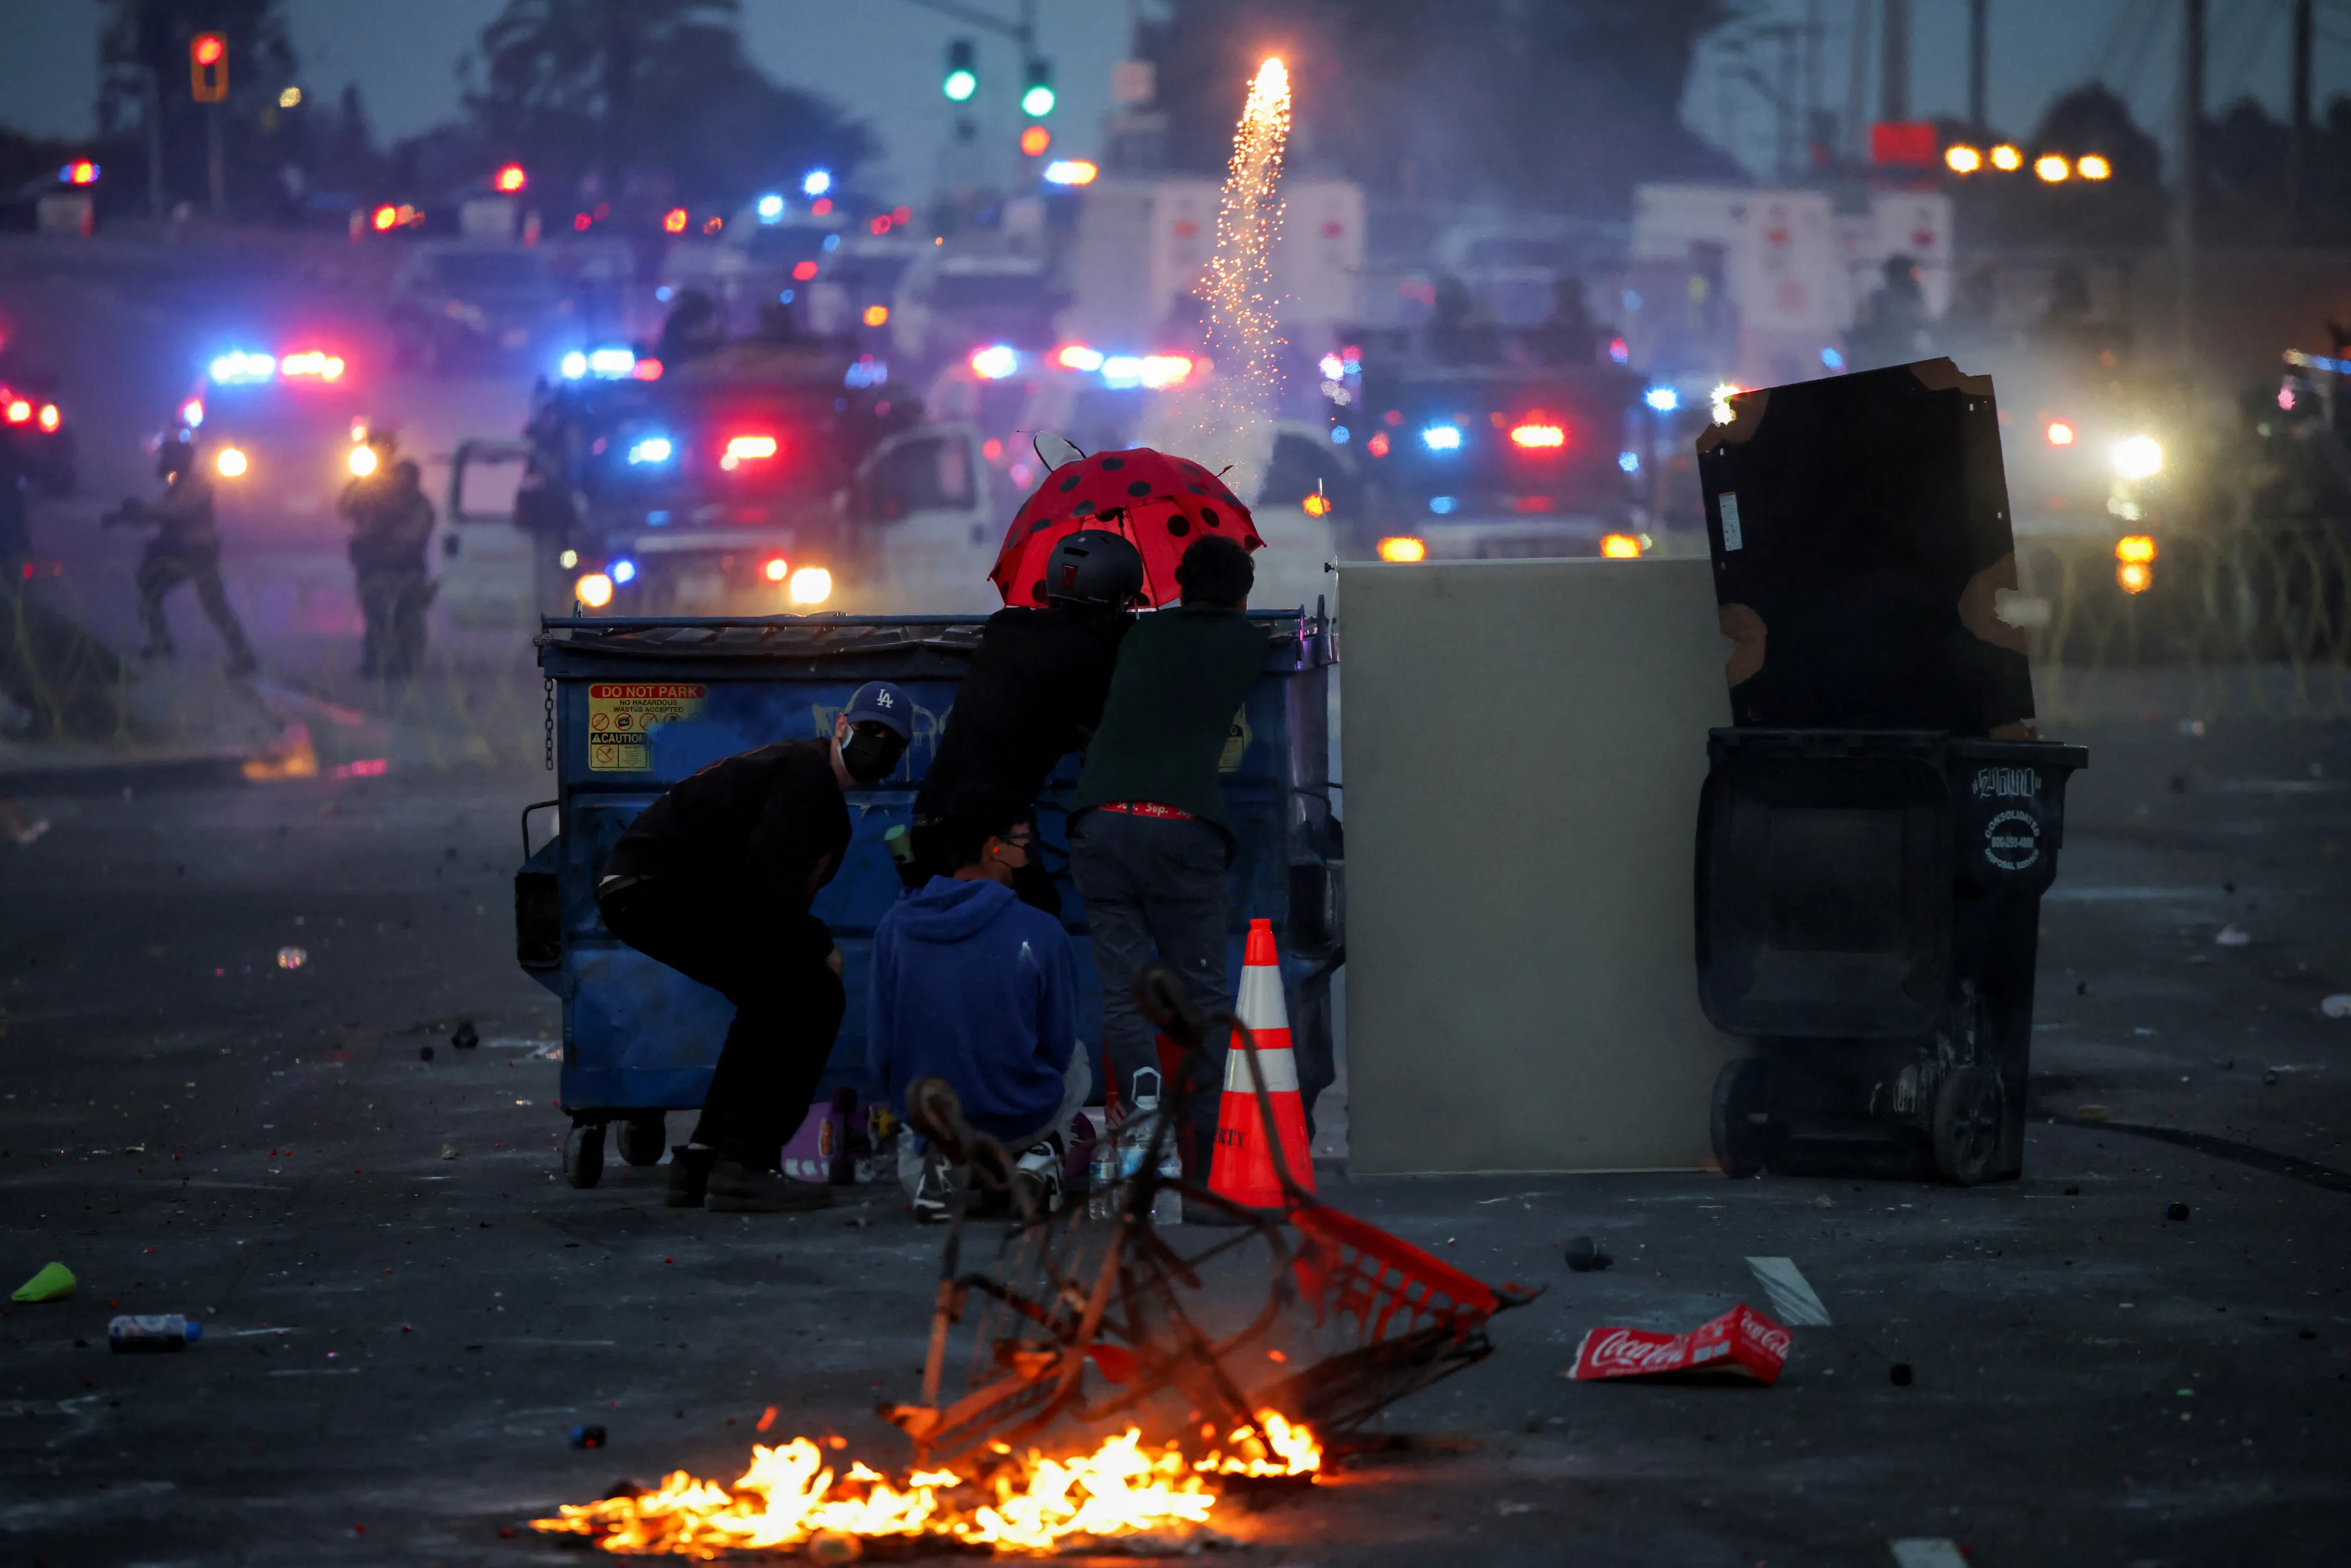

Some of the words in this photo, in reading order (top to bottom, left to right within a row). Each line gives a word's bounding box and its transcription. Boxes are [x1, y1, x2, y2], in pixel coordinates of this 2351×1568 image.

[602, 686, 622, 698] DO
[626, 686, 655, 698] NOT
[659, 686, 697, 698] PARK
[876, 688, 893, 708] LA
[1145, 802, 1168, 816] Sup.
[1984, 810, 2041, 839] CONSOLIDATED
